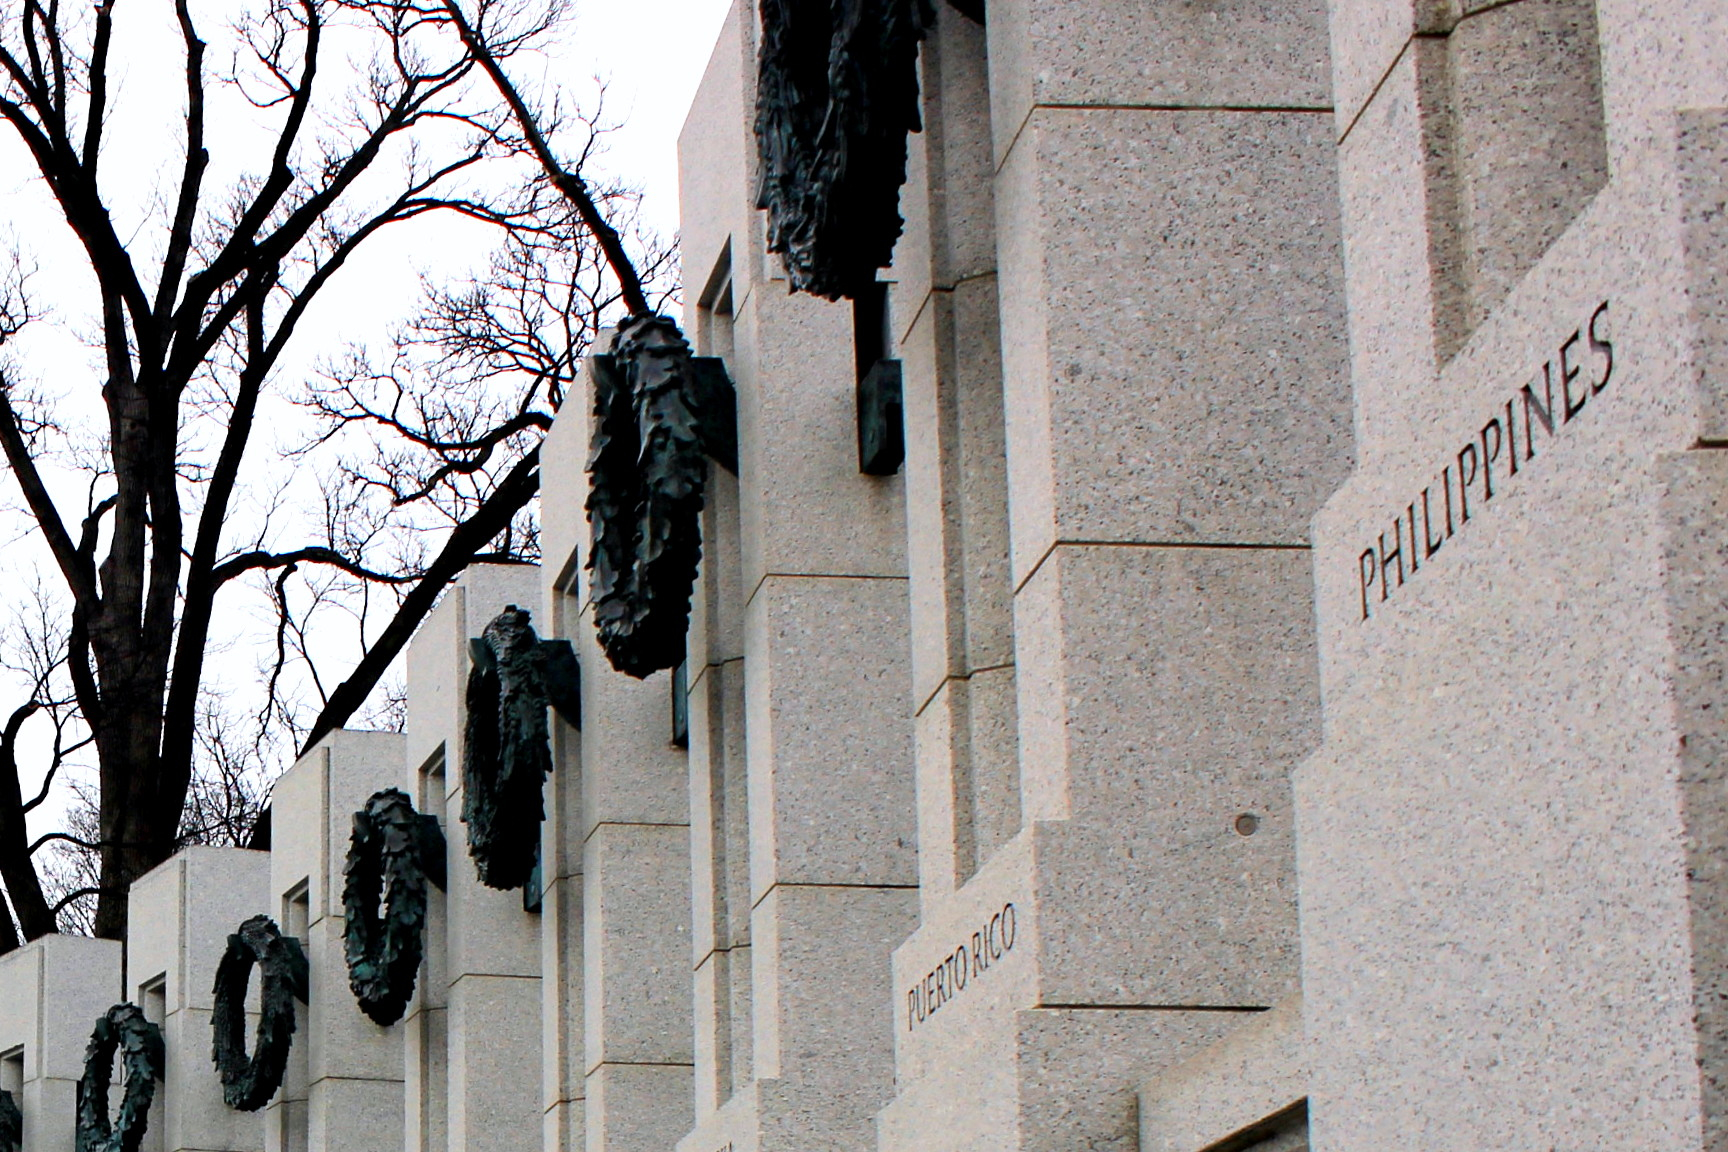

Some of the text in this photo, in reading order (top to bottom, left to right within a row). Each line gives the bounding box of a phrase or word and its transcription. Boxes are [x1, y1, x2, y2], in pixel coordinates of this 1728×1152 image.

[1358, 299, 1614, 622] PHILIPPINES
[907, 902, 1016, 1032] PUERTO RICO
